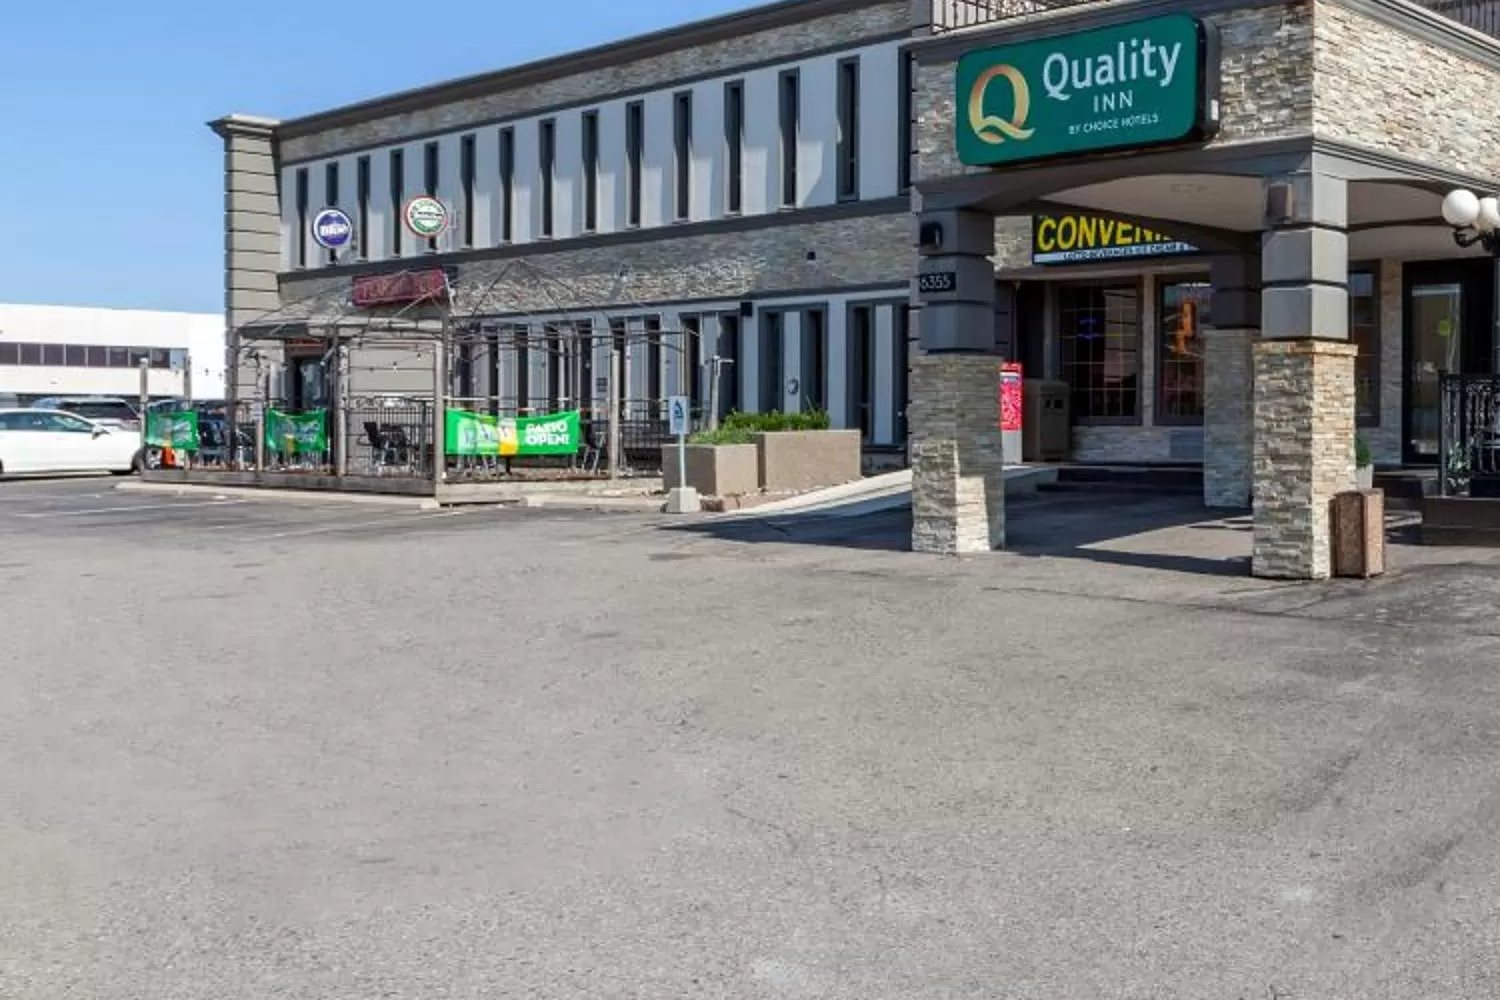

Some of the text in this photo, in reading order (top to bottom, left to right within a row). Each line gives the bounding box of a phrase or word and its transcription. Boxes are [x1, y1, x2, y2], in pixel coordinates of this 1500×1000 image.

[1043, 38, 1182, 101] Quality
[968, 64, 1036, 144] Q
[1093, 90, 1134, 113] INN
[1083, 119, 1119, 134] CHOICE
[1121, 112, 1160, 128] HOTELS
[1037, 215, 1173, 251] CONVEN
